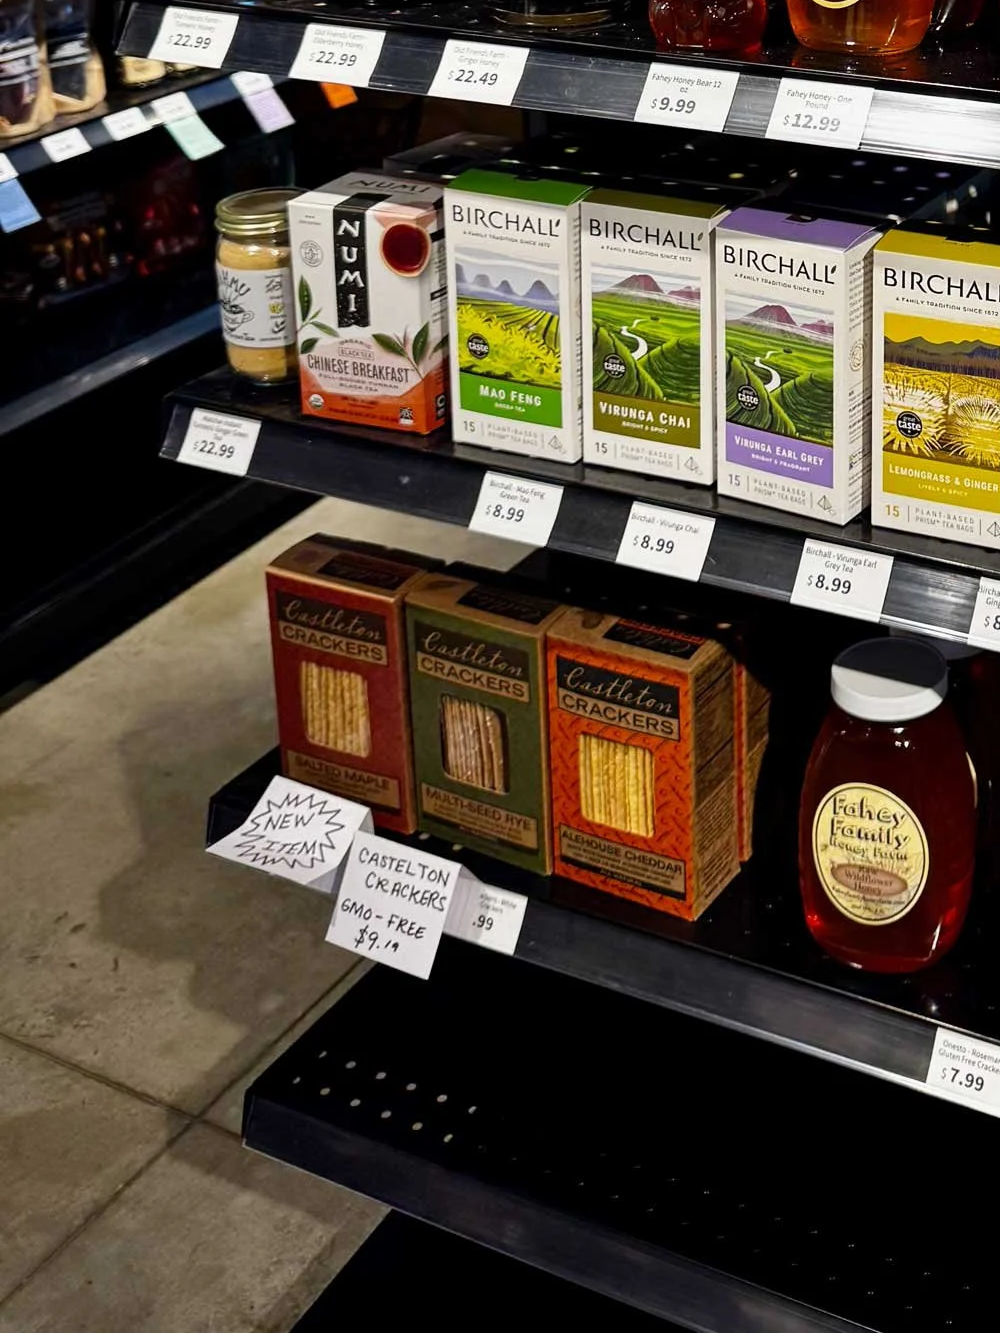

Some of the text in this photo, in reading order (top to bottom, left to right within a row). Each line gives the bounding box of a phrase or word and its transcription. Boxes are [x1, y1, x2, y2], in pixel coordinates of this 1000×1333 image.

[452, 205, 559, 237] BIRCHALL
[589, 219, 701, 251] BIRCHALL
[724, 245, 835, 286] BIRCHALL
[307, 354, 410, 383] CHINESE BREAKFAST
[479, 385, 542, 407] MAO FENG
[599, 401, 691, 429] VIRUNGA CHAI
[734, 434, 825, 467] VIRUNGA EARL GREY
[888, 464, 999, 493] LEMONGRASS GINGER
[286, 599, 383, 641] Castleton
[282, 625, 384, 661] CRACKERS
[563, 667, 674, 714] Castleton
[562, 694, 674, 735] CRACKERS
[263, 813, 317, 832] NEW
[264, 839, 318, 856] ITEM
[562, 830, 683, 875] ALEHOUSE CHEDDAR
[358, 847, 450, 886] CASTELTON
[364, 871, 448, 912] CRACKERS
